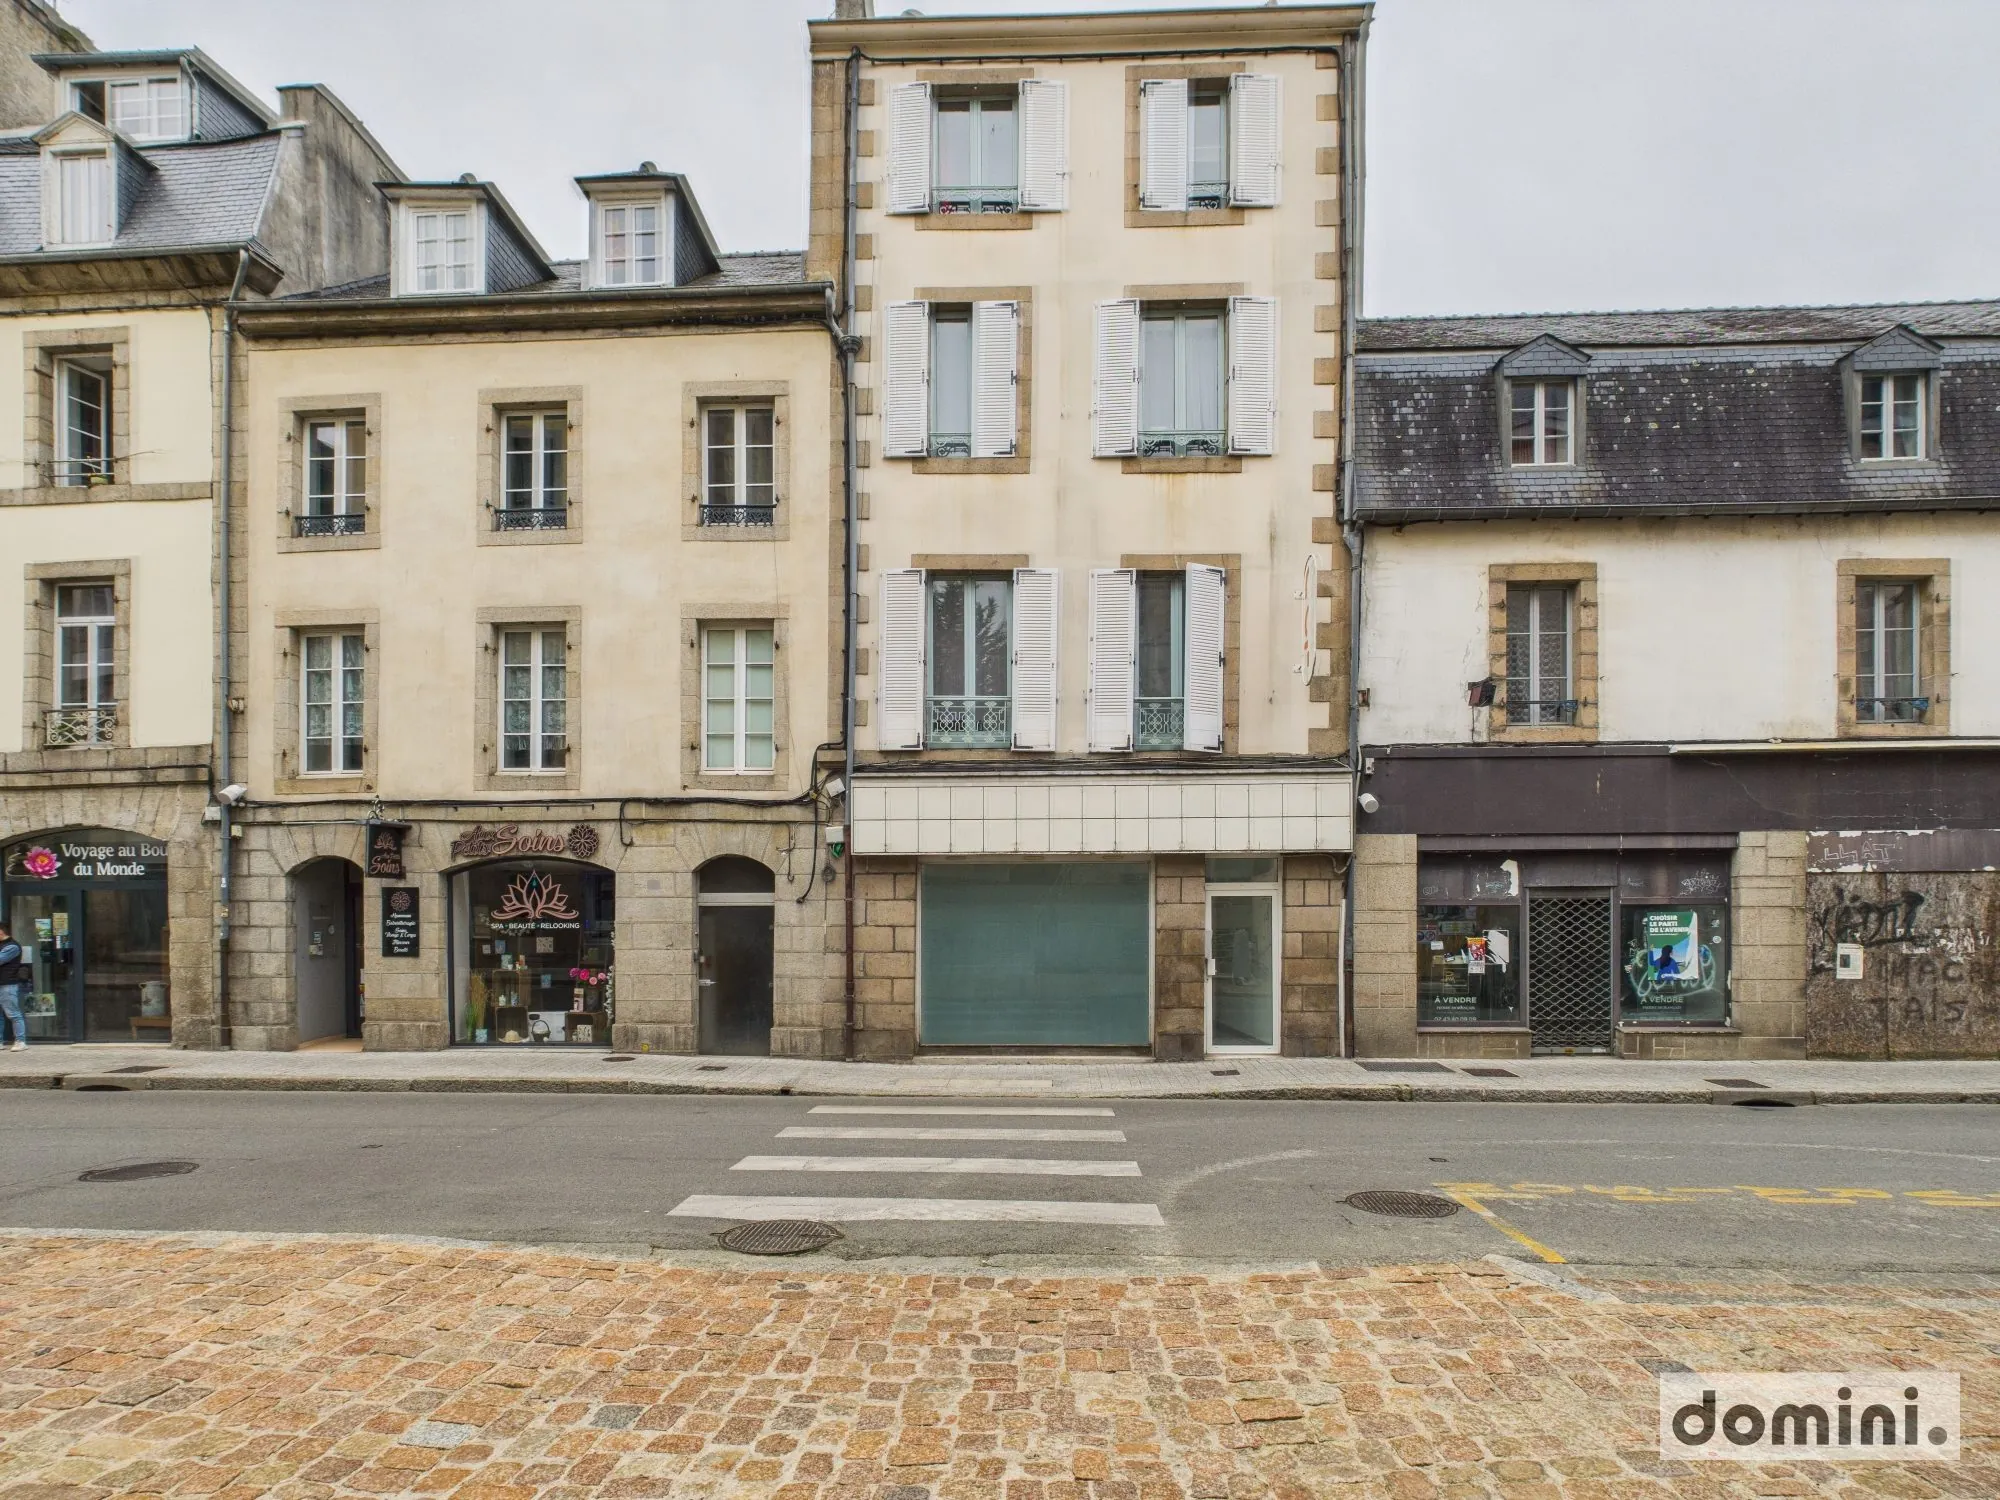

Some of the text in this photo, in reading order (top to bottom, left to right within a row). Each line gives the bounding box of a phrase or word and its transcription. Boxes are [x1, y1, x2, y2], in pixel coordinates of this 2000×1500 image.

[491, 824, 565, 855] Soins
[60, 843, 115, 860] Voyage
[118, 846, 136, 857] au
[73, 862, 145, 876] du Monde
[508, 921, 536, 929] BEAUTÉ
[1434, 995, 1478, 1004] À VENDRE
[1649, 995, 1685, 1004] VENDRE
